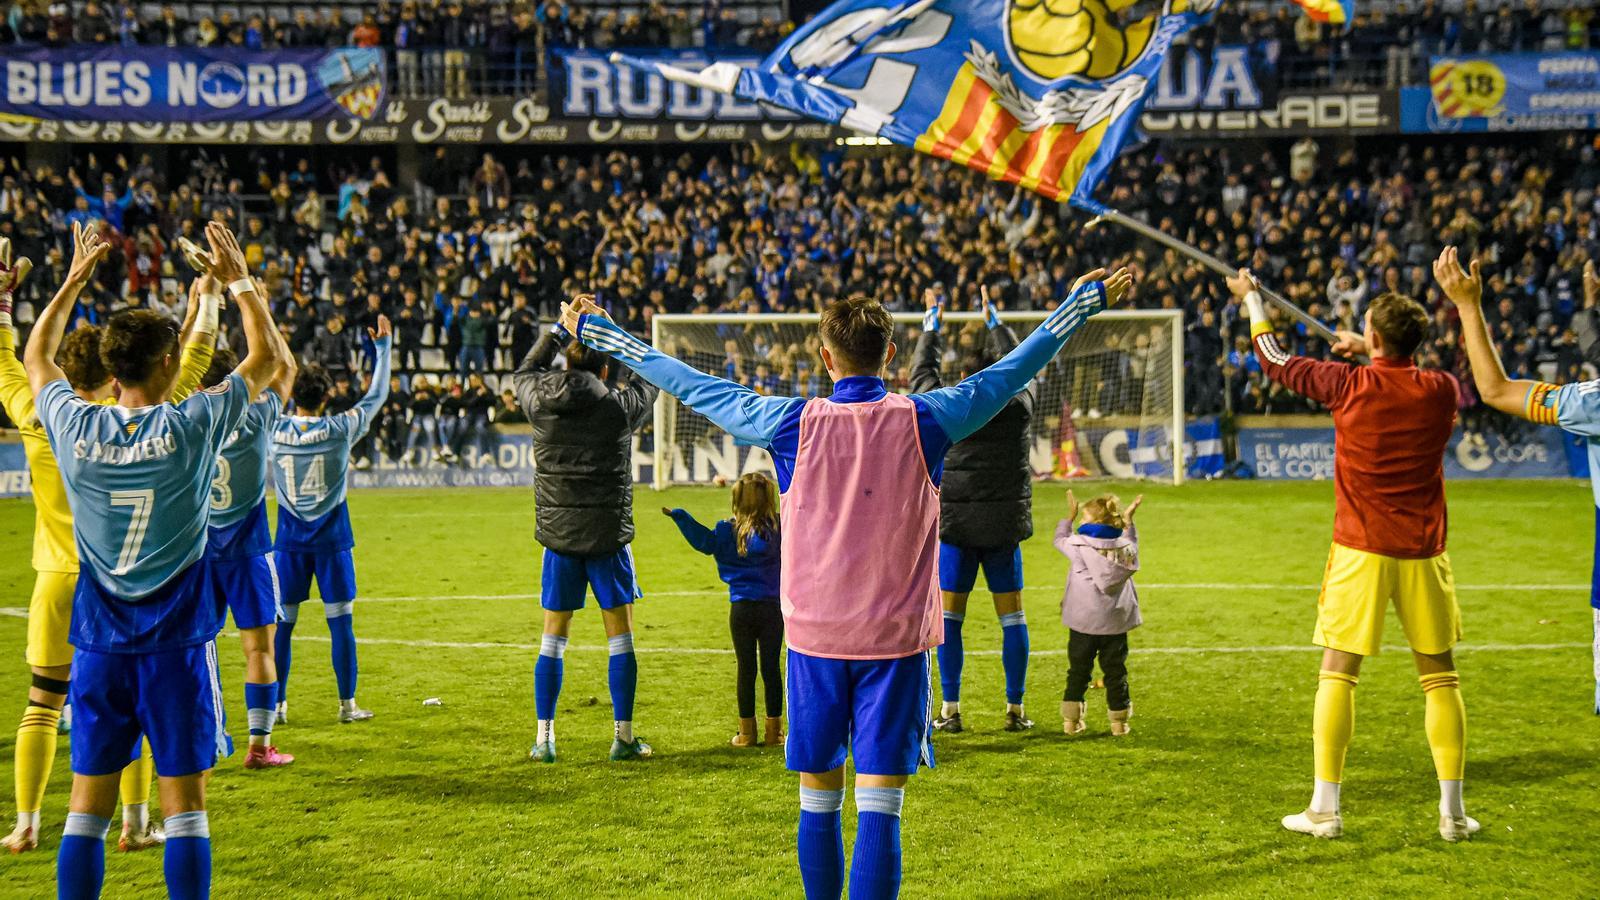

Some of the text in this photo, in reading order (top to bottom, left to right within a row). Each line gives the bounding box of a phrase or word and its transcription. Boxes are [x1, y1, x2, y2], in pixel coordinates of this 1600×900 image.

[7, 61, 151, 107] BLUES
[1462, 73, 1495, 97] 18
[1255, 442, 1335, 460] EL PARTID
[277, 454, 328, 507] 14
[1257, 461, 1281, 478] DE
[110, 488, 154, 576] 7
